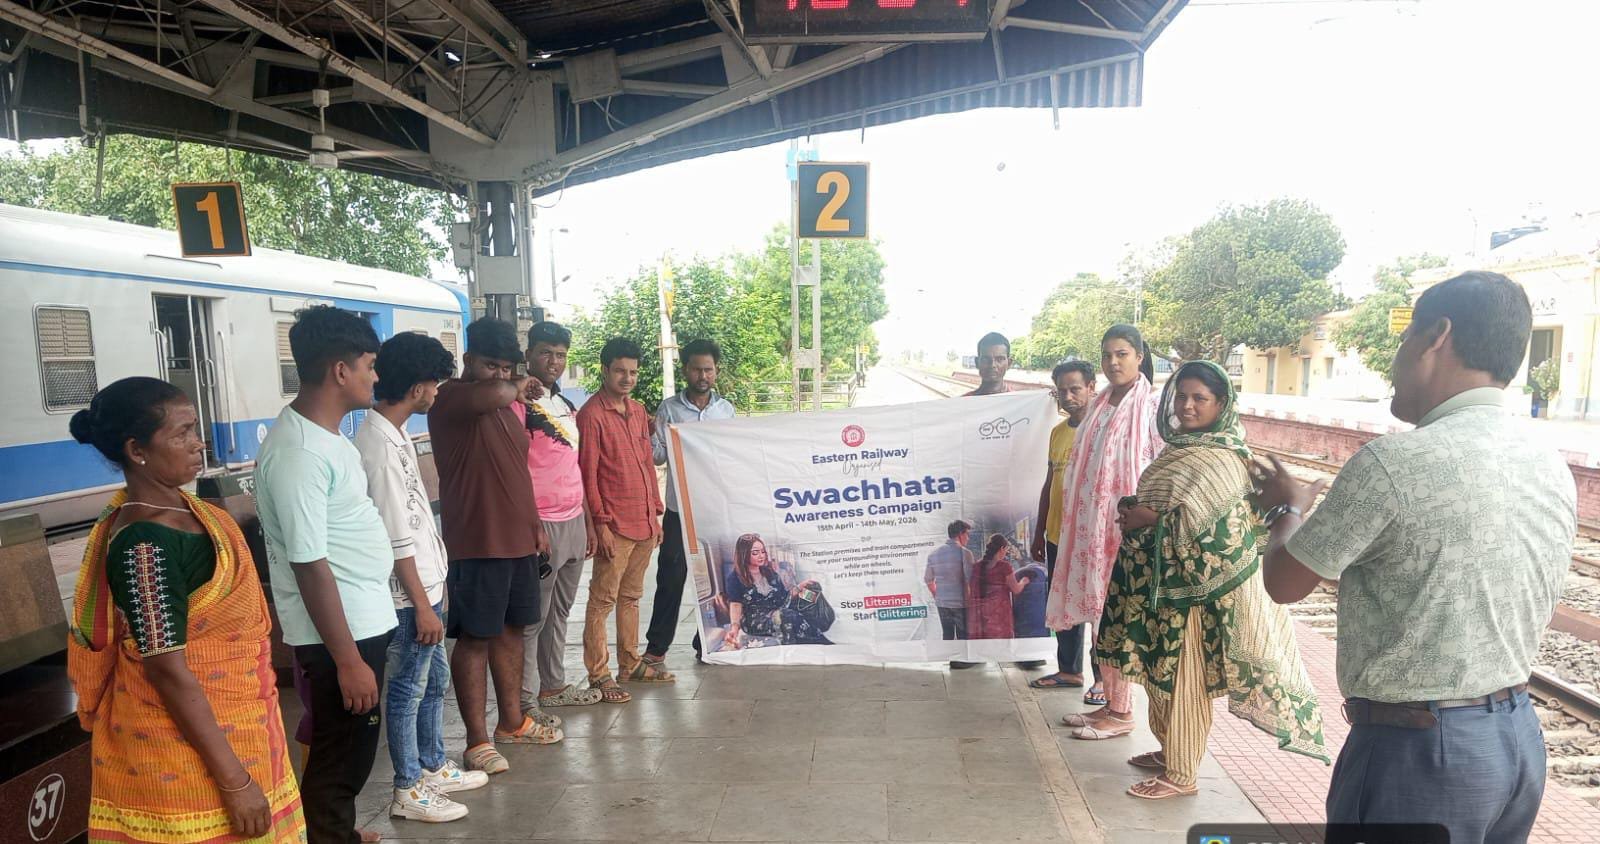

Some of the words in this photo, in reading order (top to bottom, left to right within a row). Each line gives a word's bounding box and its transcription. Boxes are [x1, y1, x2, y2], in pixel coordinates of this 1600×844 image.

[816, 171, 850, 231] 2
[196, 191, 225, 249] 1
[812, 453, 858, 464] Eastern
[861, 448, 908, 460] Railway
[774, 475, 955, 509] Swachhata
[784, 506, 864, 524] Awareness
[868, 500, 942, 516] Campaign
[818, 523, 834, 531] 15th
[835, 522, 854, 531] April
[861, 520, 878, 528] 14th
[879, 519, 896, 527] May,
[898, 517, 918, 525] 2026
[834, 548, 860, 556] premises
[890, 541, 934, 550] compartments
[842, 554, 879, 562] surrounding
[880, 568, 904, 576] spotless
[840, 600, 864, 609] Stop
[866, 598, 910, 607] Littering,
[853, 612, 877, 620] Start
[880, 608, 926, 619] Glittering
[31, 780, 62, 827] 37
